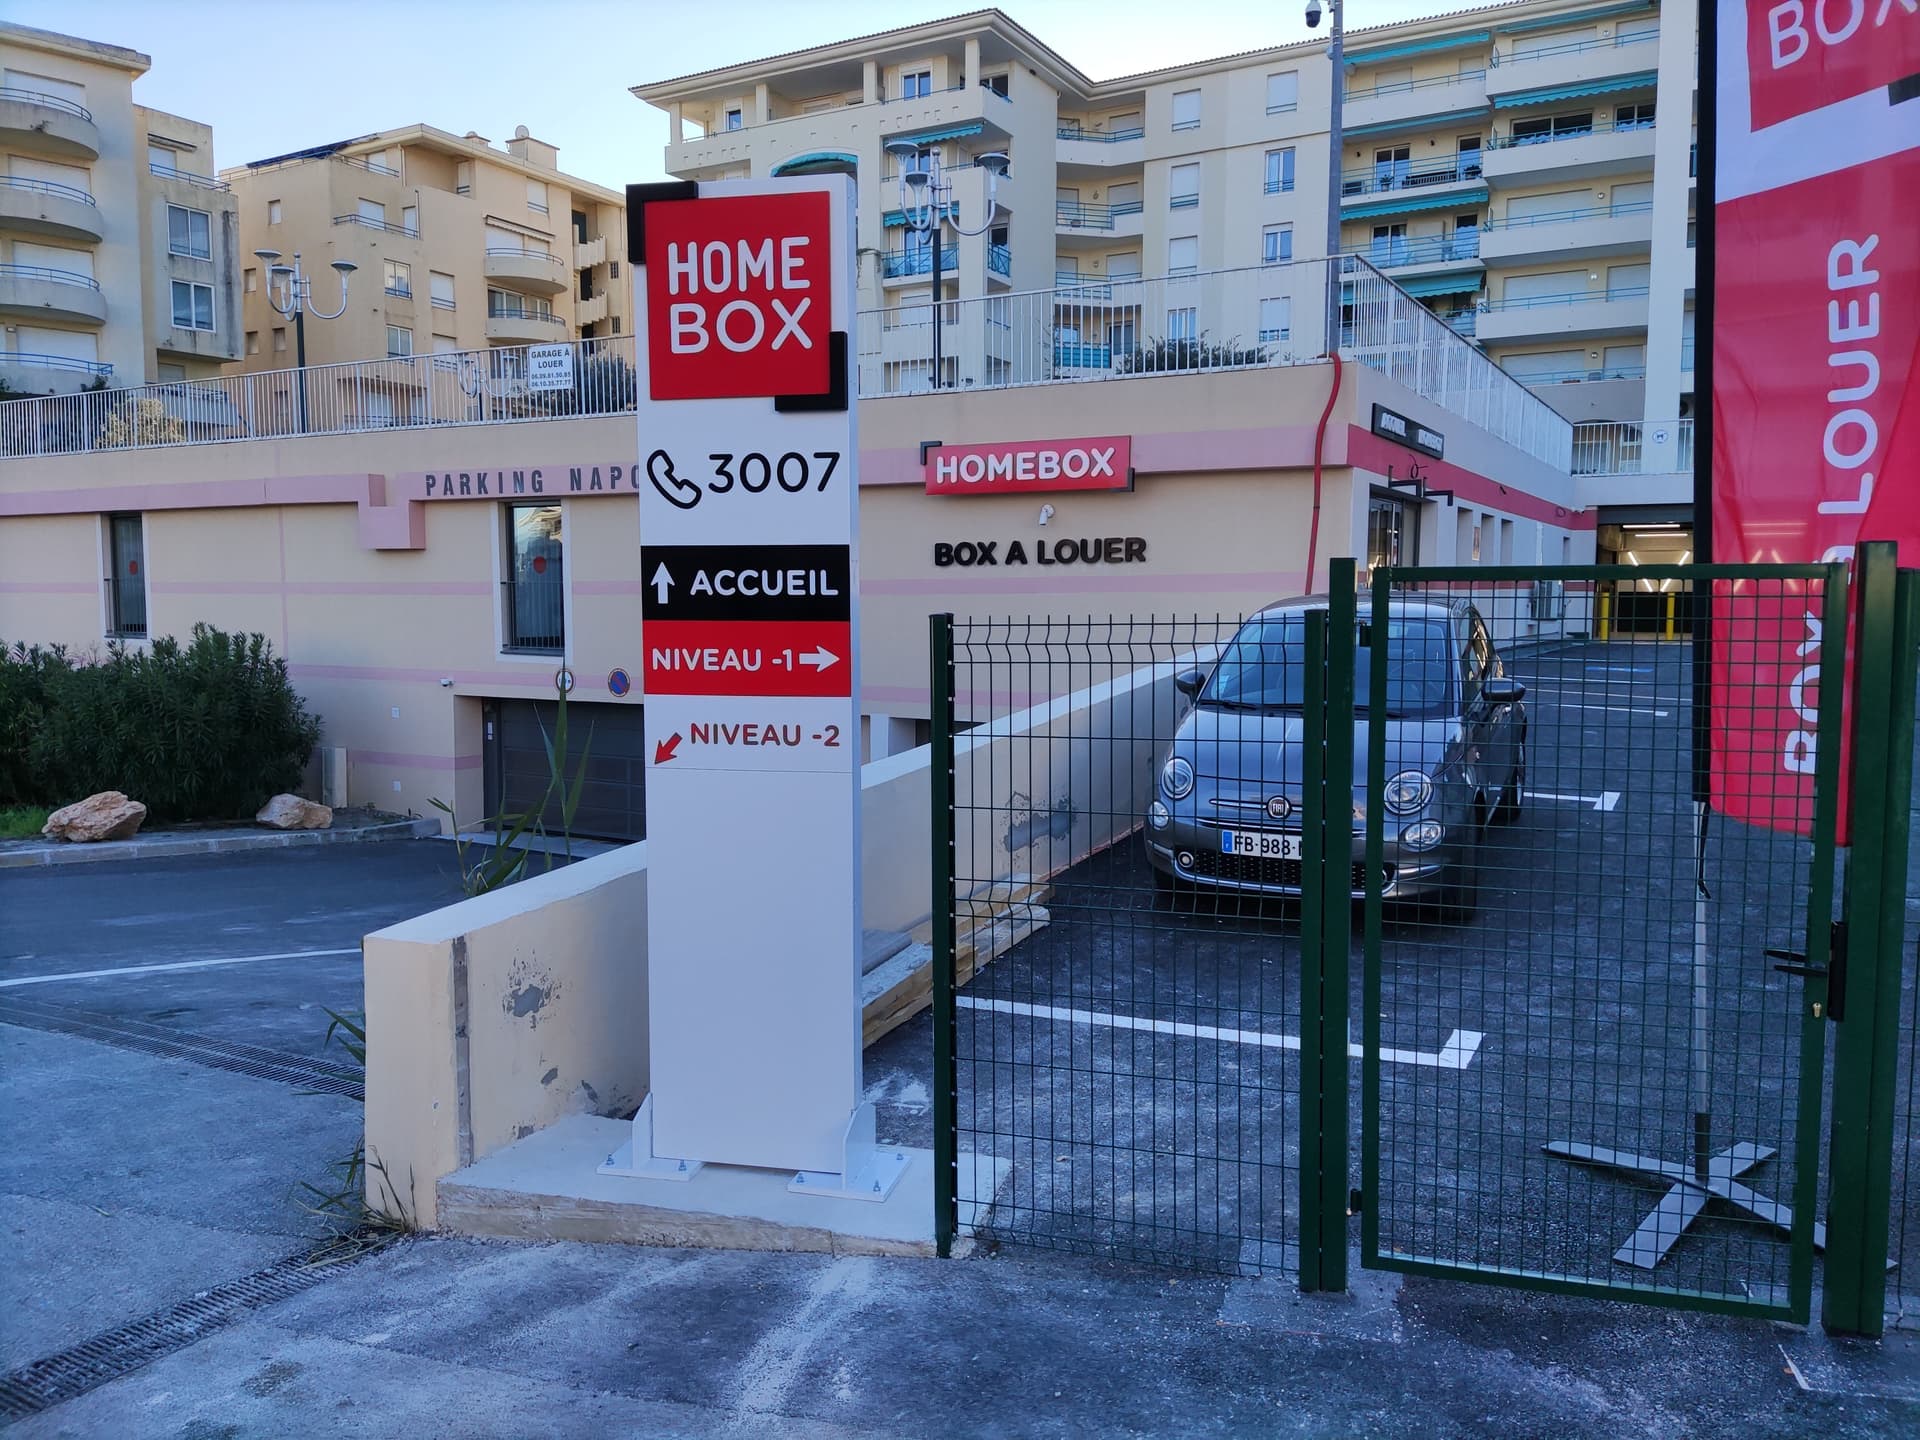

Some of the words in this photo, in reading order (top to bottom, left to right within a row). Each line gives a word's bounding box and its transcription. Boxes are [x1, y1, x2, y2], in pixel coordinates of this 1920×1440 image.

[668, 236, 811, 295] HOME
[670, 297, 813, 354] BOX
[531, 349, 562, 358] GARAGE
[538, 360, 563, 369] LOUER
[1818, 234, 1880, 514] LOUER
[708, 452, 841, 493] 3007
[936, 447, 1115, 484] HOMEBOX
[426, 469, 544, 496] PARKING
[934, 541, 997, 566] BOX
[1005, 540, 1028, 565] A
[1037, 537, 1147, 564] LOUER
[690, 569, 839, 596] ACCUEIL
[652, 648, 762, 671] NIVEAU
[772, 649, 793, 671] -1
[691, 723, 801, 746] NIVEAU
[812, 725, 841, 747] -2
[1272, 803, 1284, 814] FIAT
